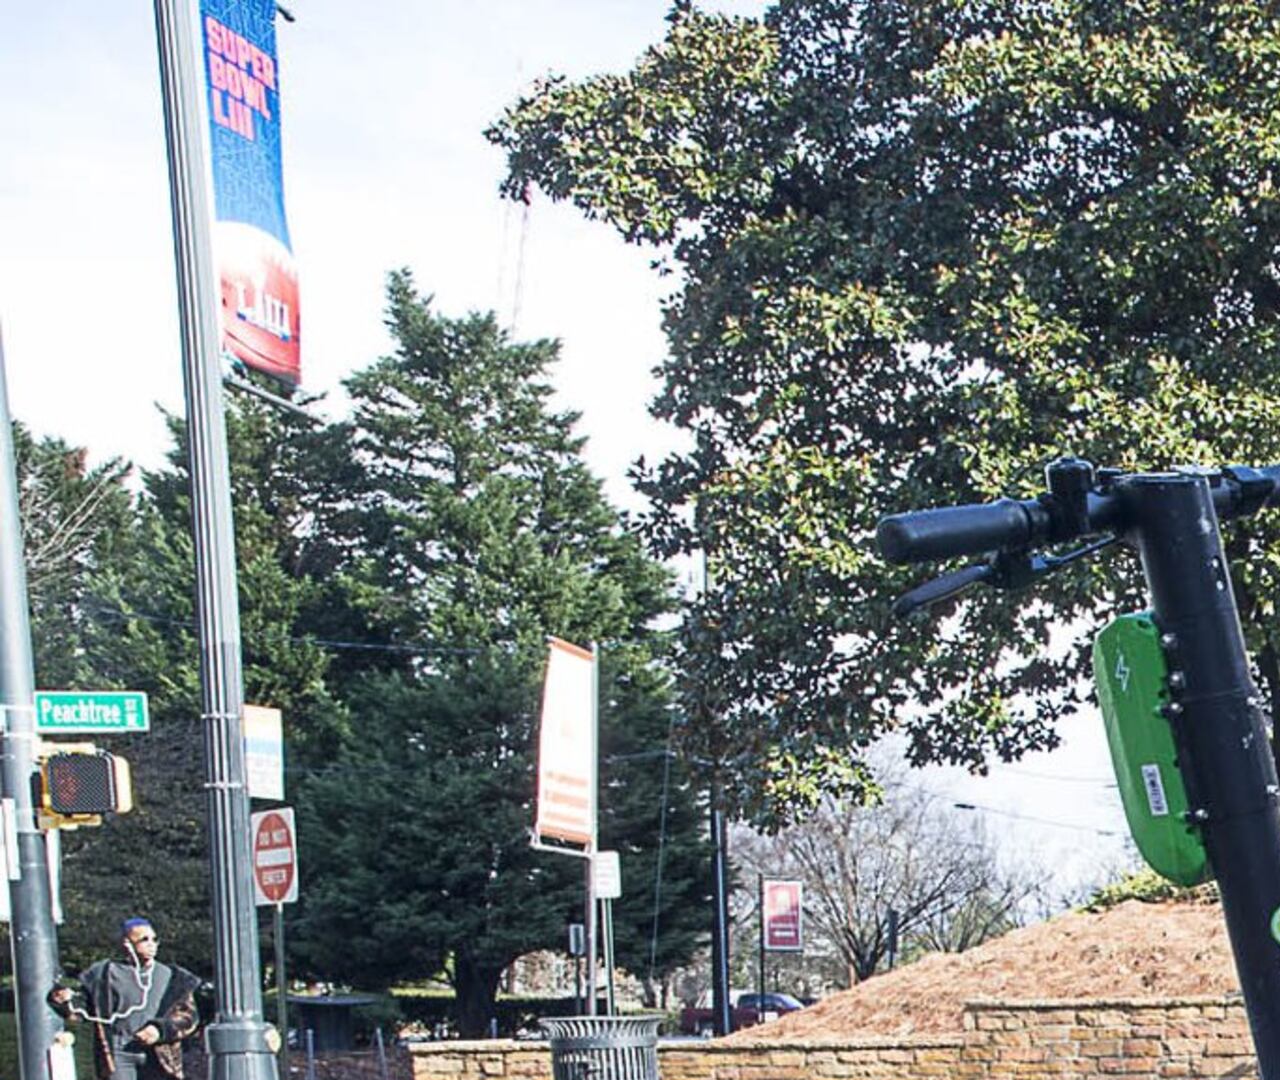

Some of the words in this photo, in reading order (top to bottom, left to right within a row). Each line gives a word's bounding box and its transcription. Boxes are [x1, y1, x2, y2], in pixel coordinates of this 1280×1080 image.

[205, 15, 276, 91] SUPER
[209, 49, 271, 121] BOWL
[212, 88, 254, 140] LIII
[41, 698, 121, 724] Peachtree
